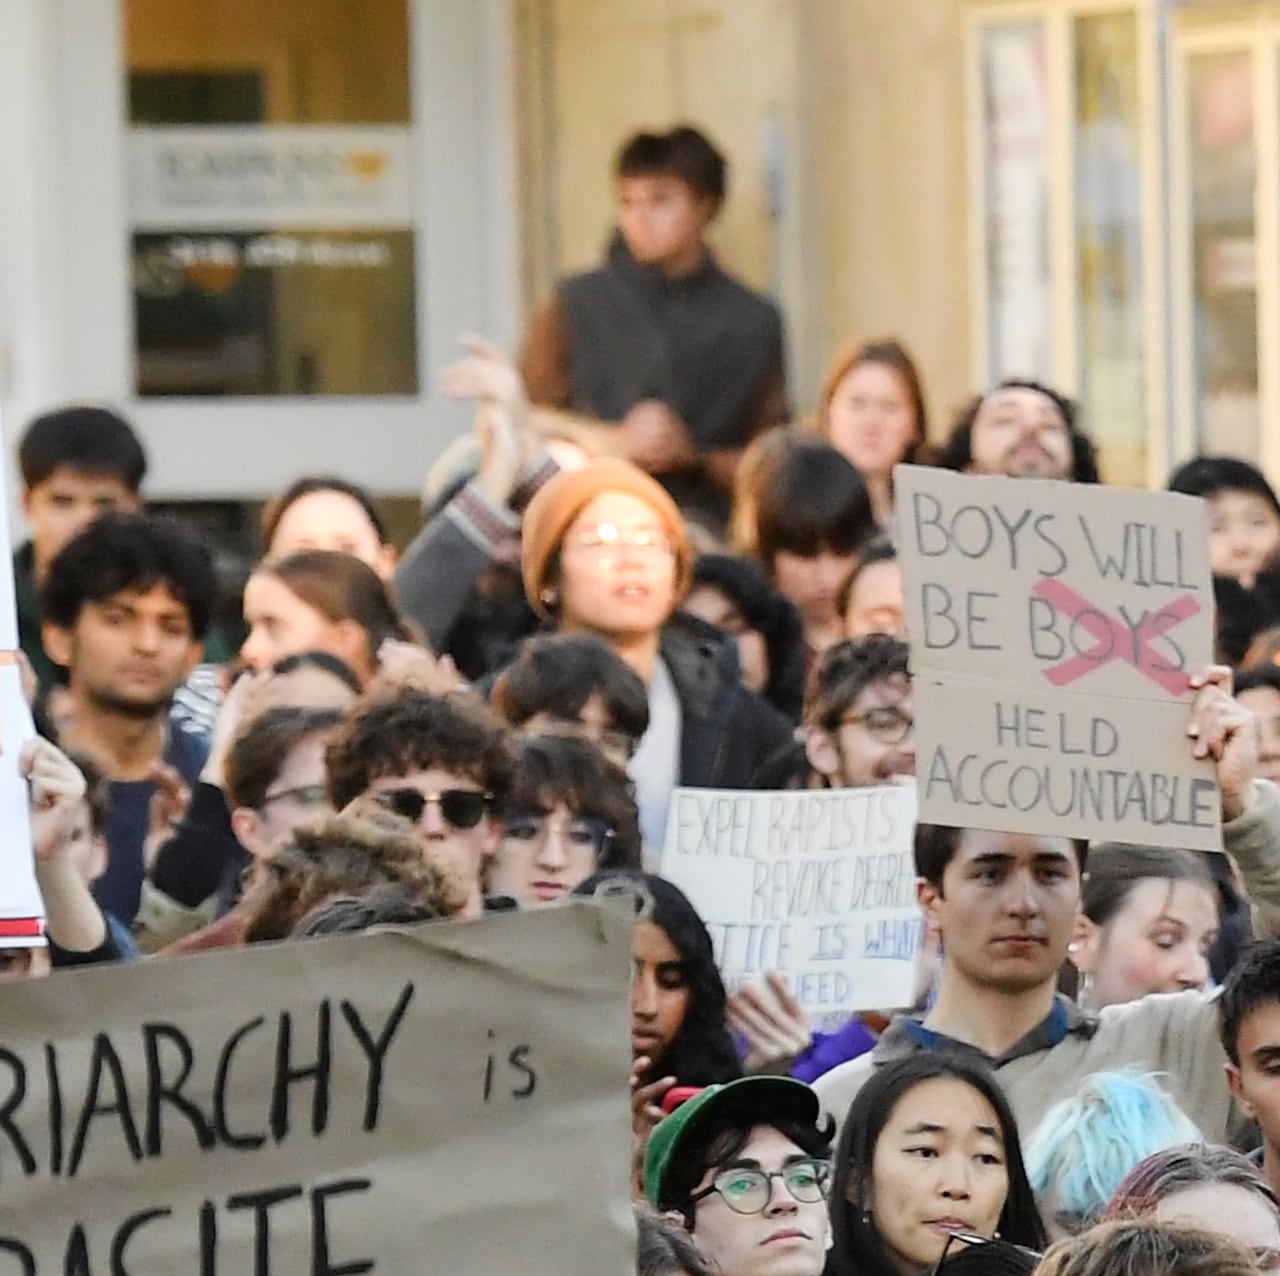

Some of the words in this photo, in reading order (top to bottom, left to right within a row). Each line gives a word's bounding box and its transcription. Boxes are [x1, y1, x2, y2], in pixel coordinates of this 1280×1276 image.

[913, 493, 1068, 577] BOYS
[1078, 515, 1199, 590] WILL
[922, 583, 1002, 651] BE
[1028, 597, 1186, 672] BOYS
[995, 703, 1119, 758] HELD
[926, 745, 1216, 828] ACCOUNTABLE
[676, 795, 754, 859] EXPEL
[767, 791, 897, 854] RAPISTS
[750, 857, 846, 920] REVOKE
[809, 922, 848, 961] IS
[482, 1029, 539, 1100] is
